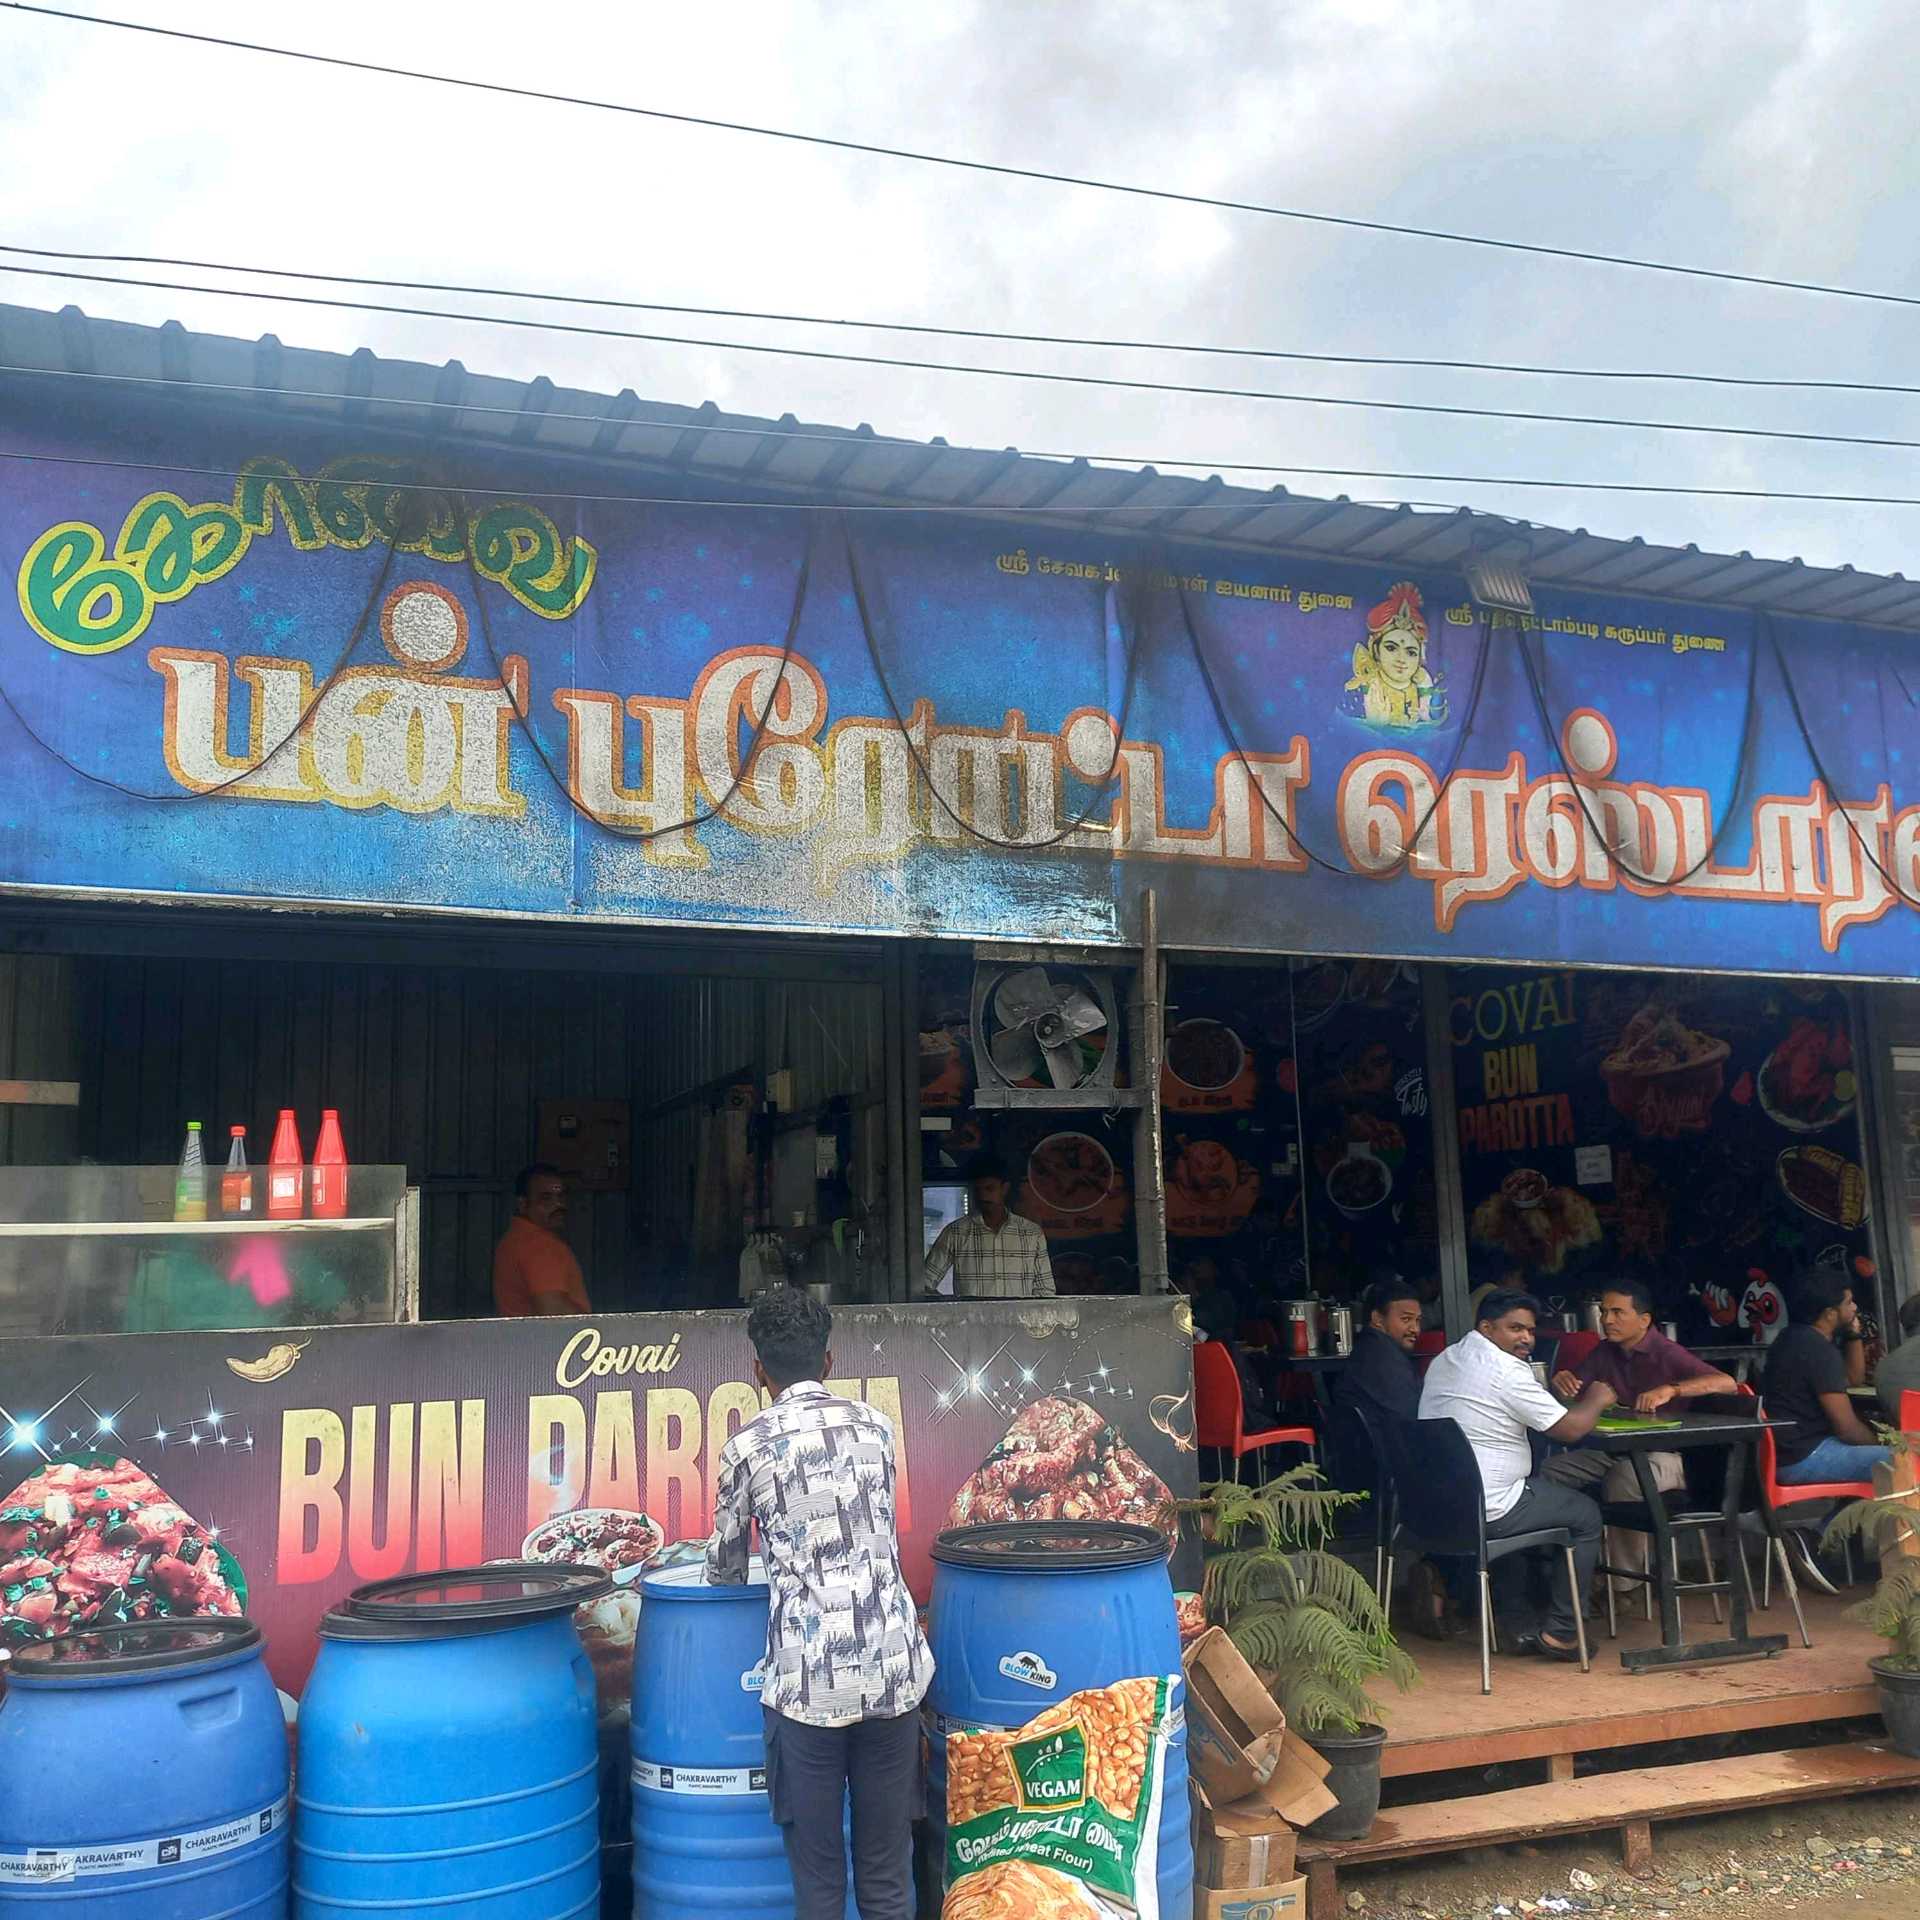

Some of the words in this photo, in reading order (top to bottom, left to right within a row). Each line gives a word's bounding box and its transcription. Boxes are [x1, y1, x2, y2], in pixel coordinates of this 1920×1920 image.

[1215, 579, 1292, 603] ஐயனார்
[1604, 624, 1666, 646] கருப்பர்
[147, 579, 530, 818] பன்
[551, 643, 1310, 895] புரோட்டா
[1449, 971, 1577, 1046] COVAI
[1483, 1043, 1539, 1100] BUN
[1459, 1093, 1575, 1153] PAROTTA
[555, 1327, 681, 1389] Covai
[276, 1399, 486, 1585] BUN
[1004, 1662, 1030, 1678] BLOW
[1030, 1669, 1052, 1684] KING
[676, 1772, 738, 1785] CHAKRAVARTHY
[1026, 1778, 1081, 1799] VEGAM
[185, 1824, 253, 1850] CHAKRAVARTHY
[1053, 1848, 1094, 1874] Flour)
